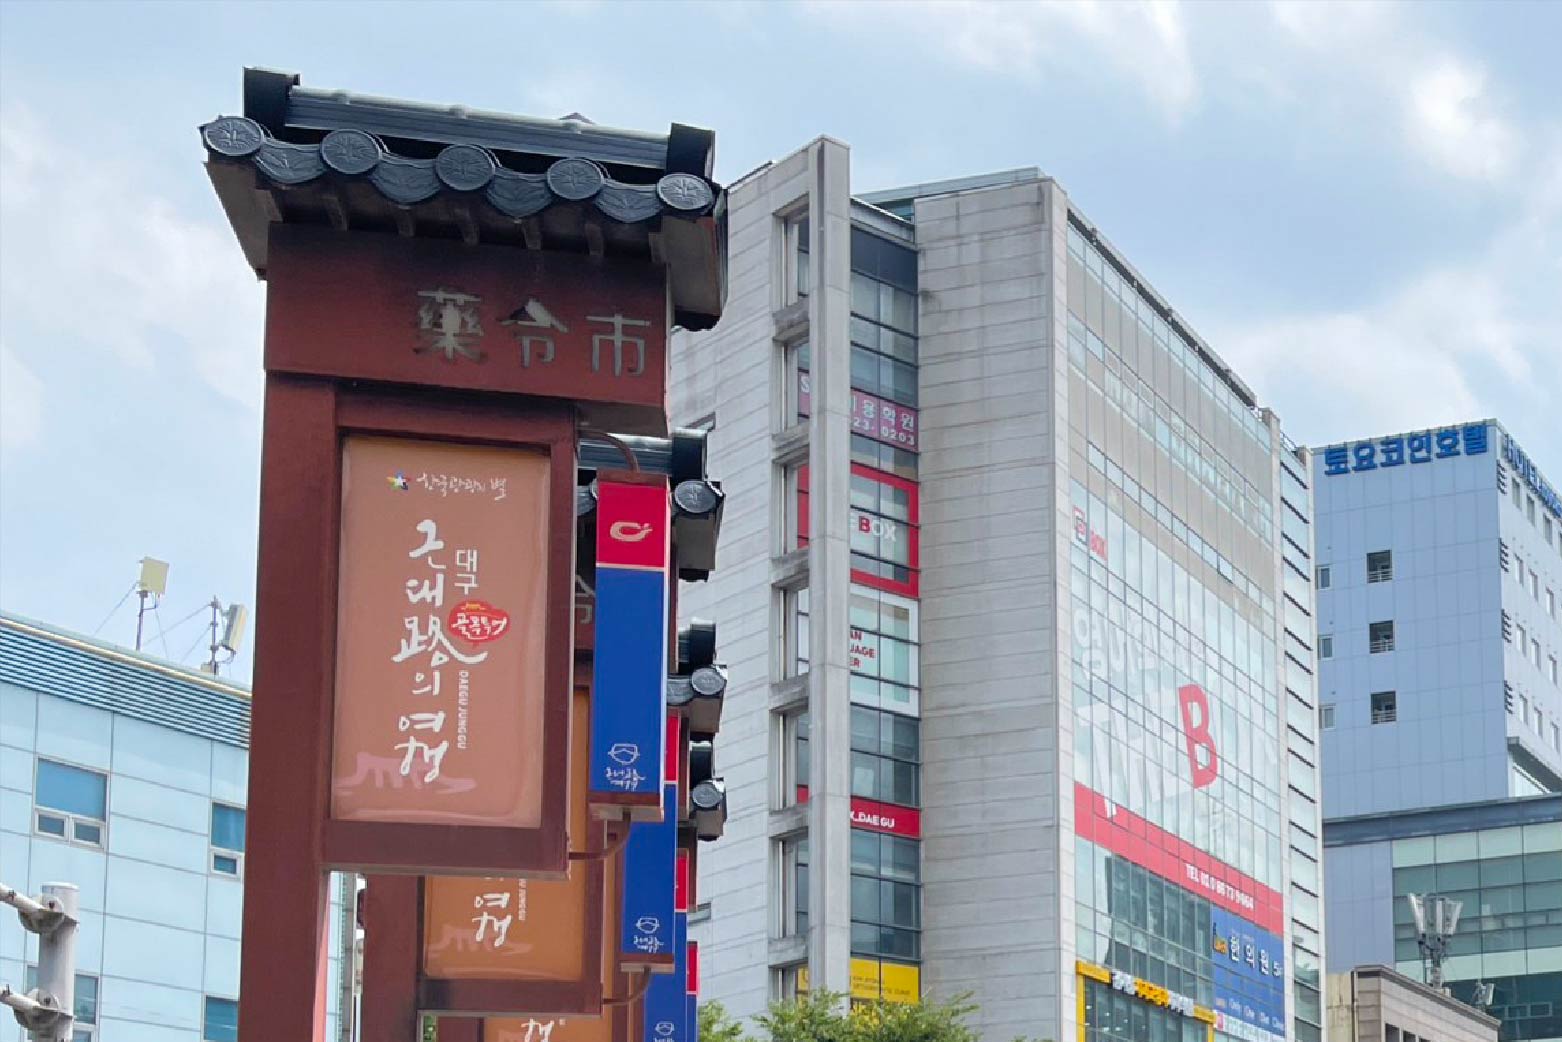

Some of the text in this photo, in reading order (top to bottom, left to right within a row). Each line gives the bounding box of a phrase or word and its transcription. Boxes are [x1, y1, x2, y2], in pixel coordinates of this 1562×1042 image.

[415, 290, 650, 378] 藥令市
[1325, 425, 1488, 476] 토요코인호텔
[454, 549, 479, 595] 대구
[457, 671, 469, 749] DAEGU JUNGGU
